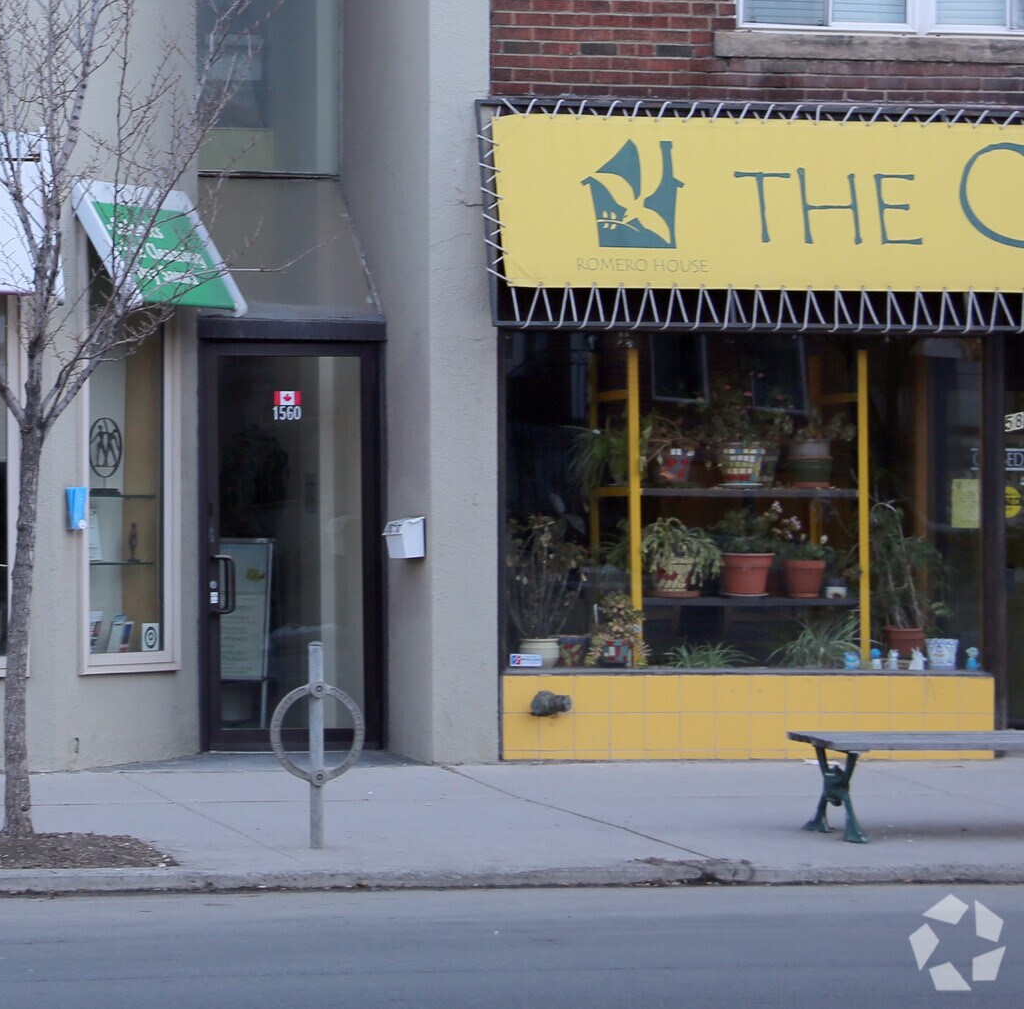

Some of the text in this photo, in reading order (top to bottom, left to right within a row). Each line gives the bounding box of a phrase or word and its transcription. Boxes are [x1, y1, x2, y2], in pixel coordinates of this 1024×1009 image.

[733, 167, 924, 245] THE
[575, 257, 710, 273] ROMERO HOUSE
[272, 405, 303, 421] 1560
